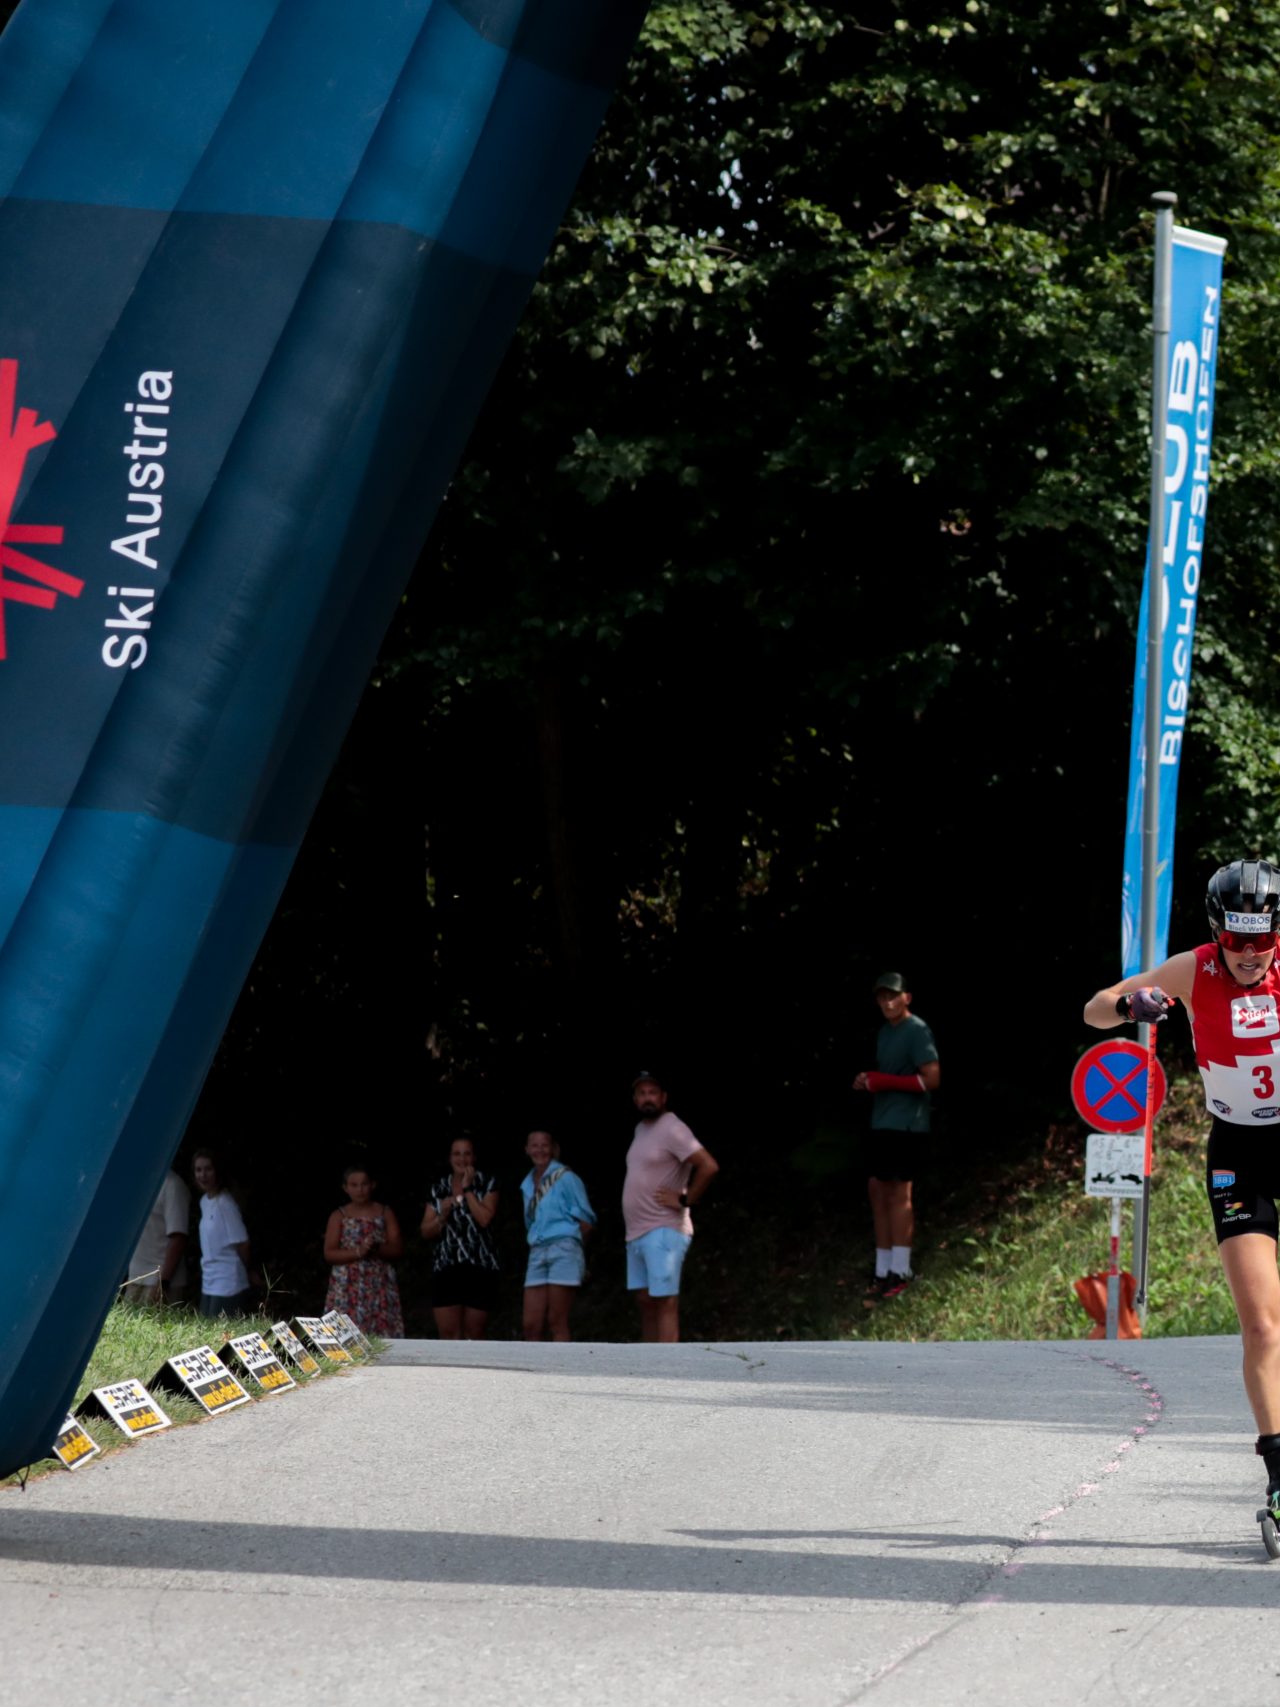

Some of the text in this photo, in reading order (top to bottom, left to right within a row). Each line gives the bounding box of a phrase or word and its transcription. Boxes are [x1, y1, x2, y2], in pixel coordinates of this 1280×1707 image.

[101, 369, 174, 670] Ski Austria
[1158, 286, 1218, 766] BISCHOFSHOFEN
[1159, 339, 1200, 632] LUB
[1241, 916, 1270, 925] OBOS
[1252, 1065, 1275, 1100] 3
